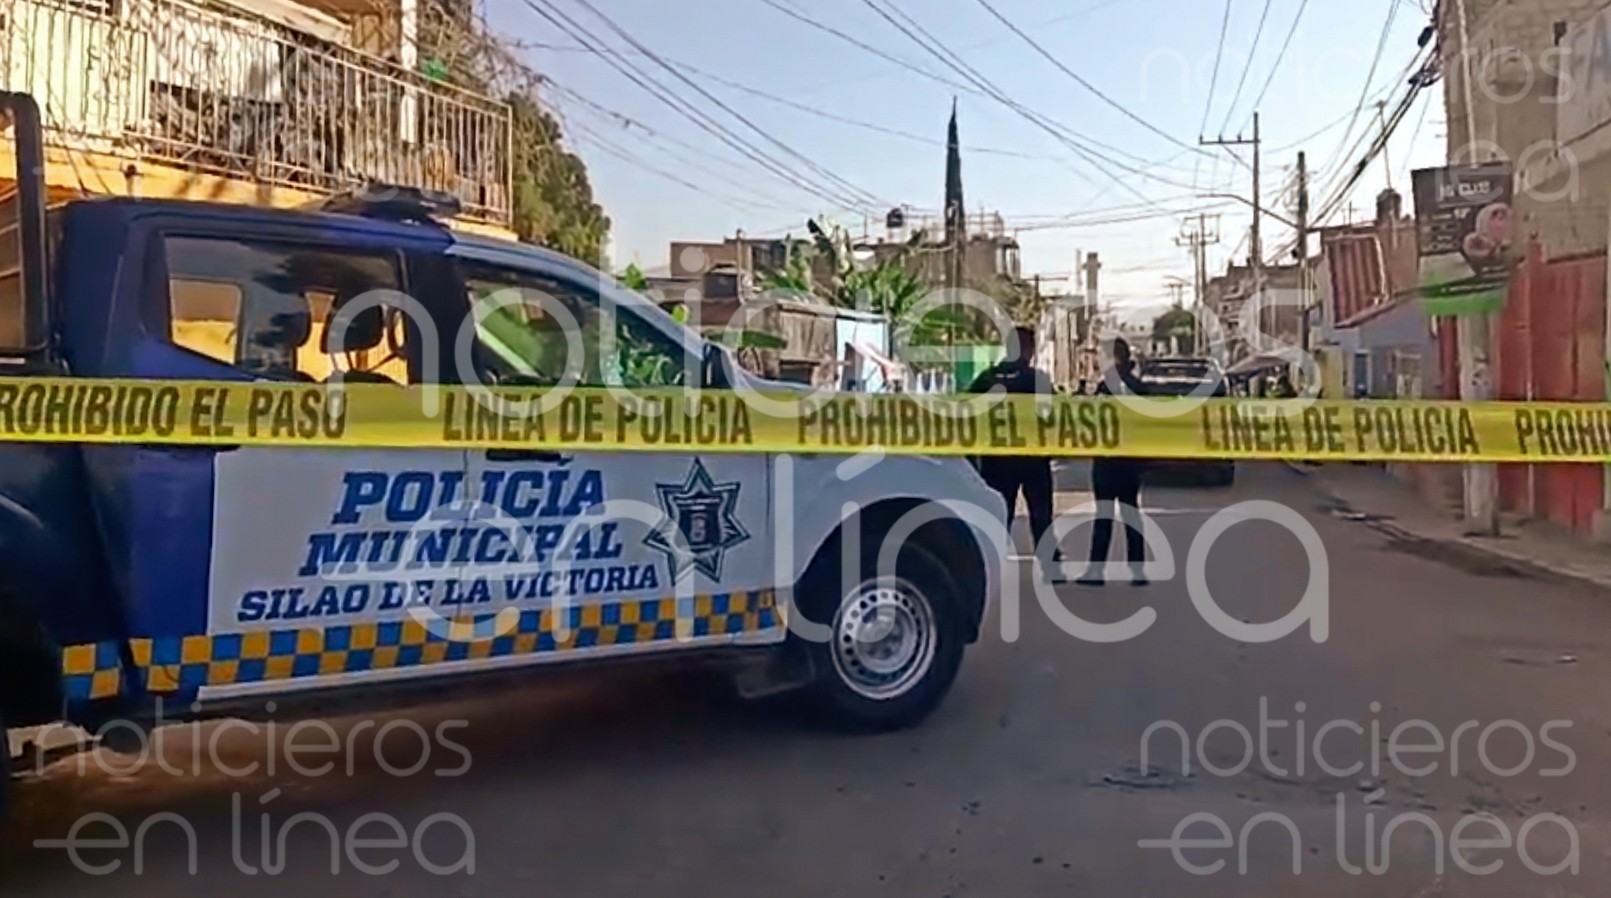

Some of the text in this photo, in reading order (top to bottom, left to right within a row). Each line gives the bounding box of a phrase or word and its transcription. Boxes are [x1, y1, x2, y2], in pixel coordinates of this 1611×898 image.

[190, 387, 234, 437] EL
[249, 388, 346, 439] PASO
[442, 391, 753, 445] LINEA DE POLICIA
[797, 398, 1120, 449] PROHIBIDO EL PASO
[1201, 405, 1480, 456] LINEA DE POLICIA
[1514, 408, 1611, 456] PROHI
[332, 458, 606, 525] POLICÍA
[298, 521, 624, 577] MUNICIPAL
[236, 562, 659, 623] SILAO DE LA VICTORIA
